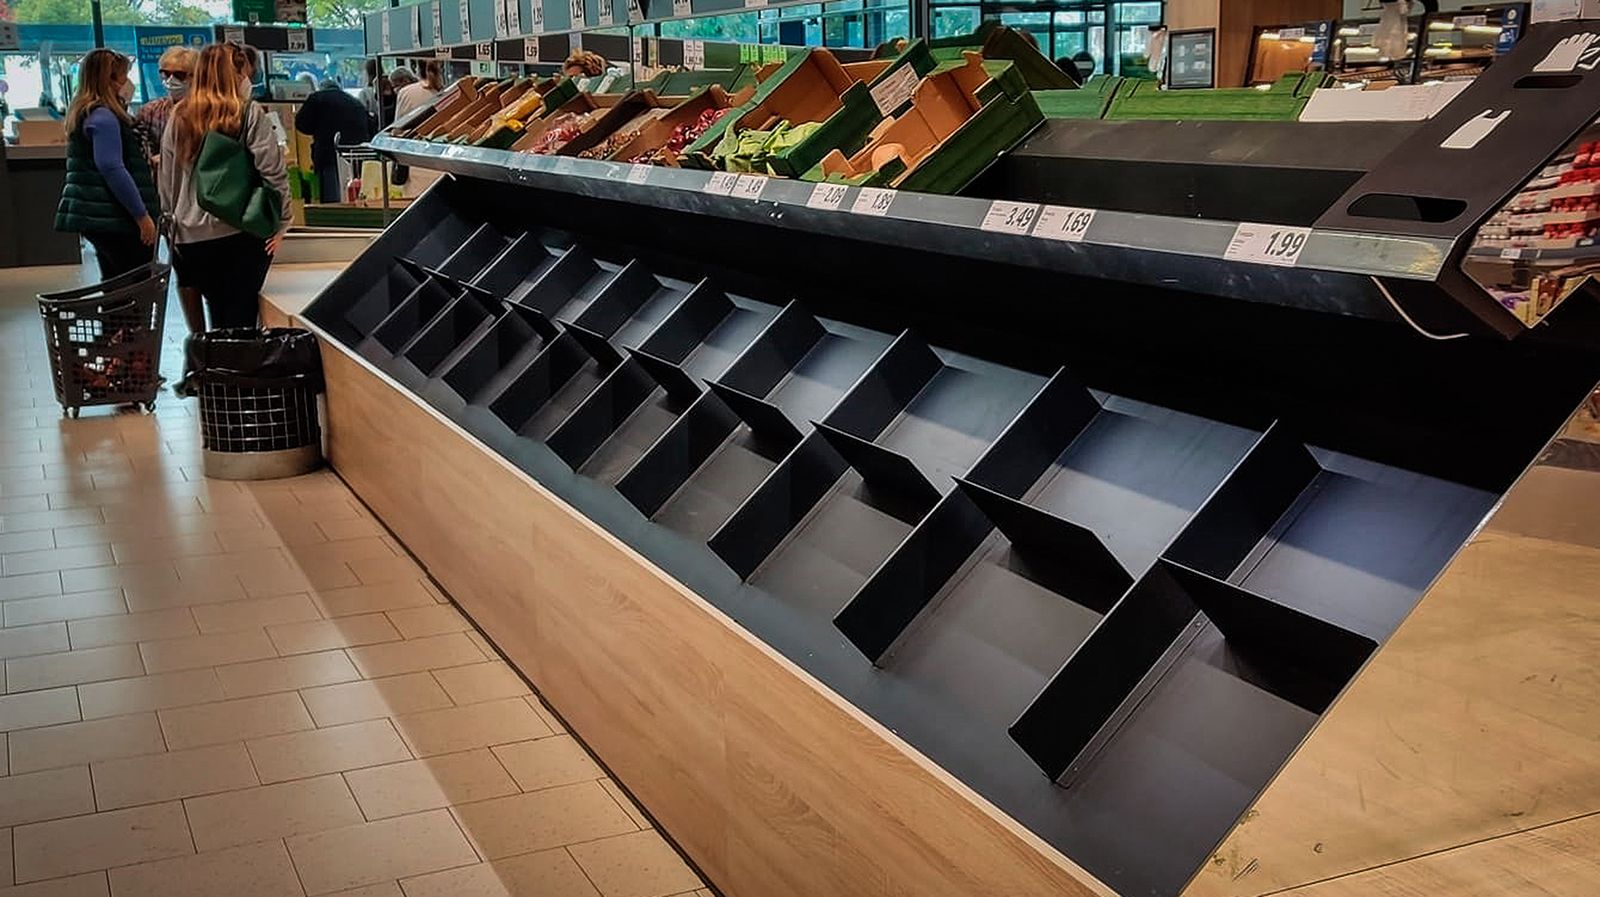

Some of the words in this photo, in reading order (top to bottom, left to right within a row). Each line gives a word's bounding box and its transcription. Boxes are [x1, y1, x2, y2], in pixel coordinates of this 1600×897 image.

[824, 187, 845, 205] 2.09
[872, 192, 893, 210] 1.89
[1005, 207, 1035, 227] 3.49
[1061, 211, 1091, 233] 1.69
[1264, 231, 1305, 257] 1.99
